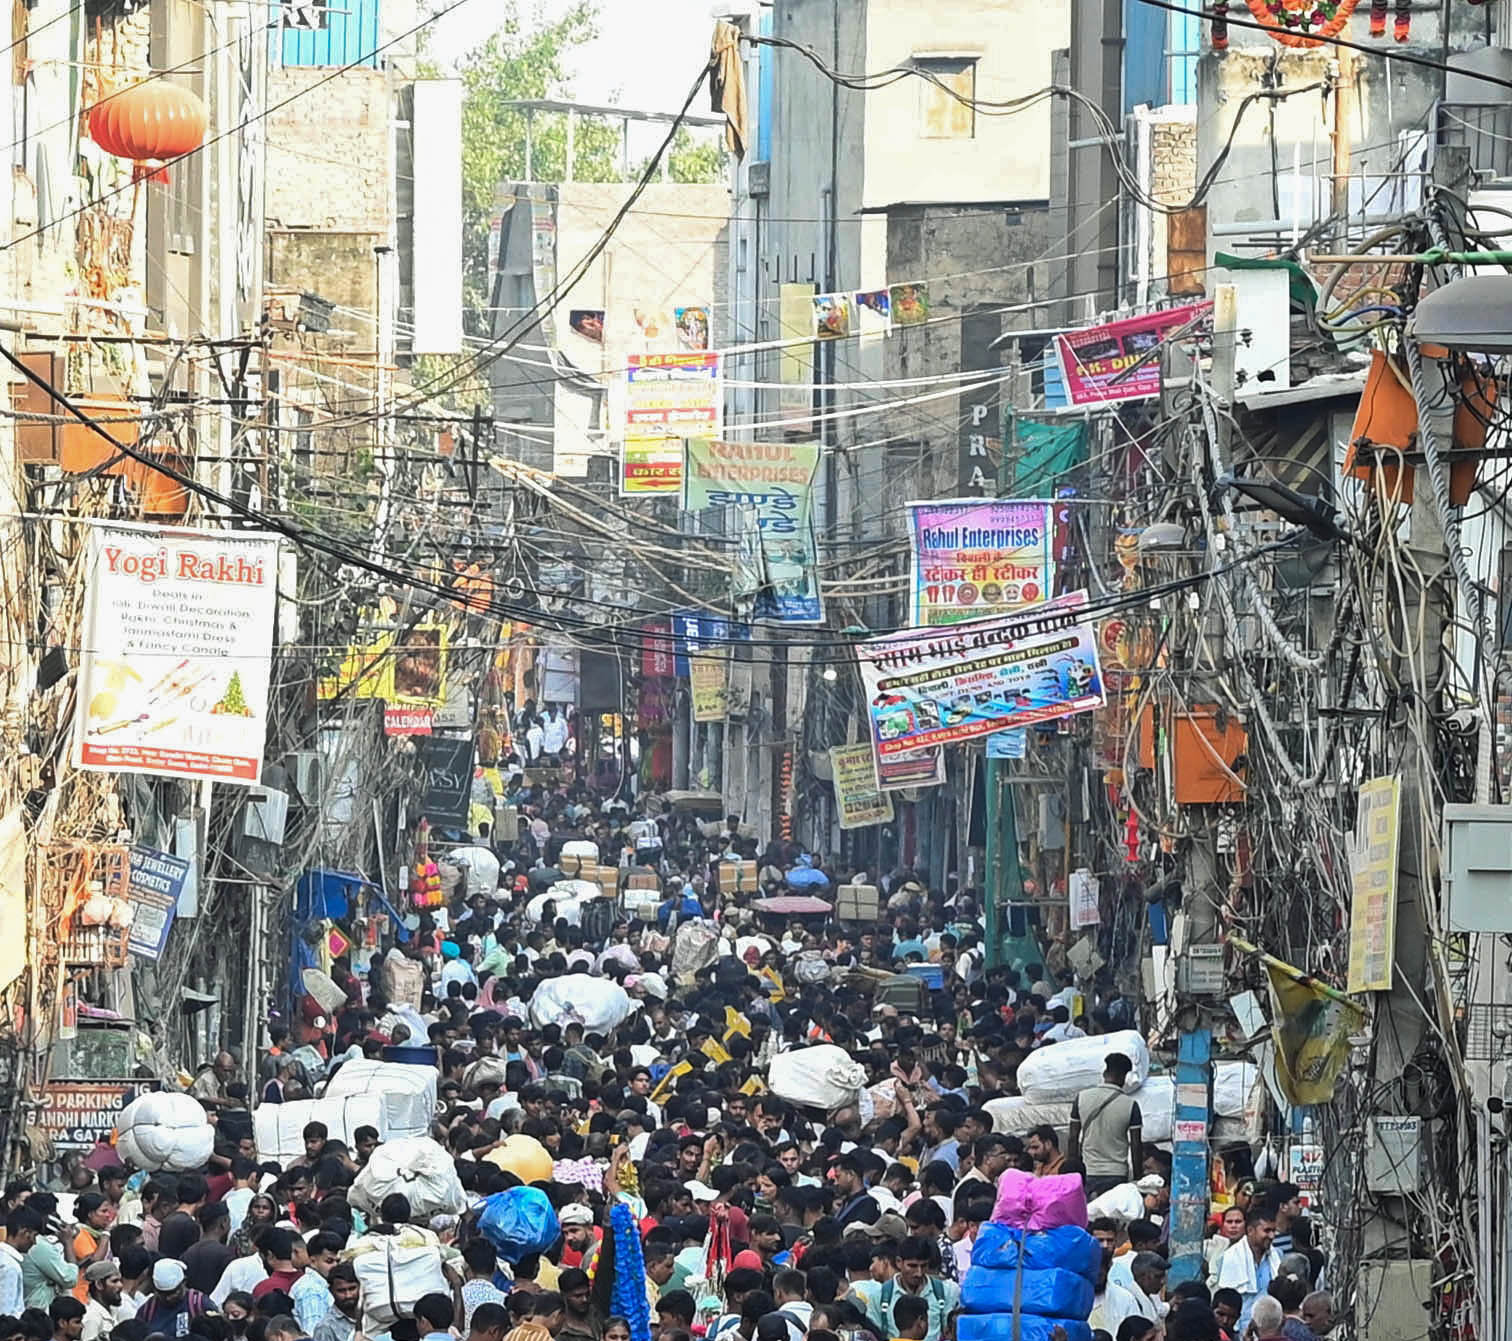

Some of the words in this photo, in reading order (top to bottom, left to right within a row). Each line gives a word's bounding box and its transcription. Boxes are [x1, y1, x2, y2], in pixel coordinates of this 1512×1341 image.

[923, 527, 959, 549] Rahul
[962, 526, 1039, 549] Enterprises
[105, 547, 168, 583] Yogi
[178, 552, 264, 585] Rakhi
